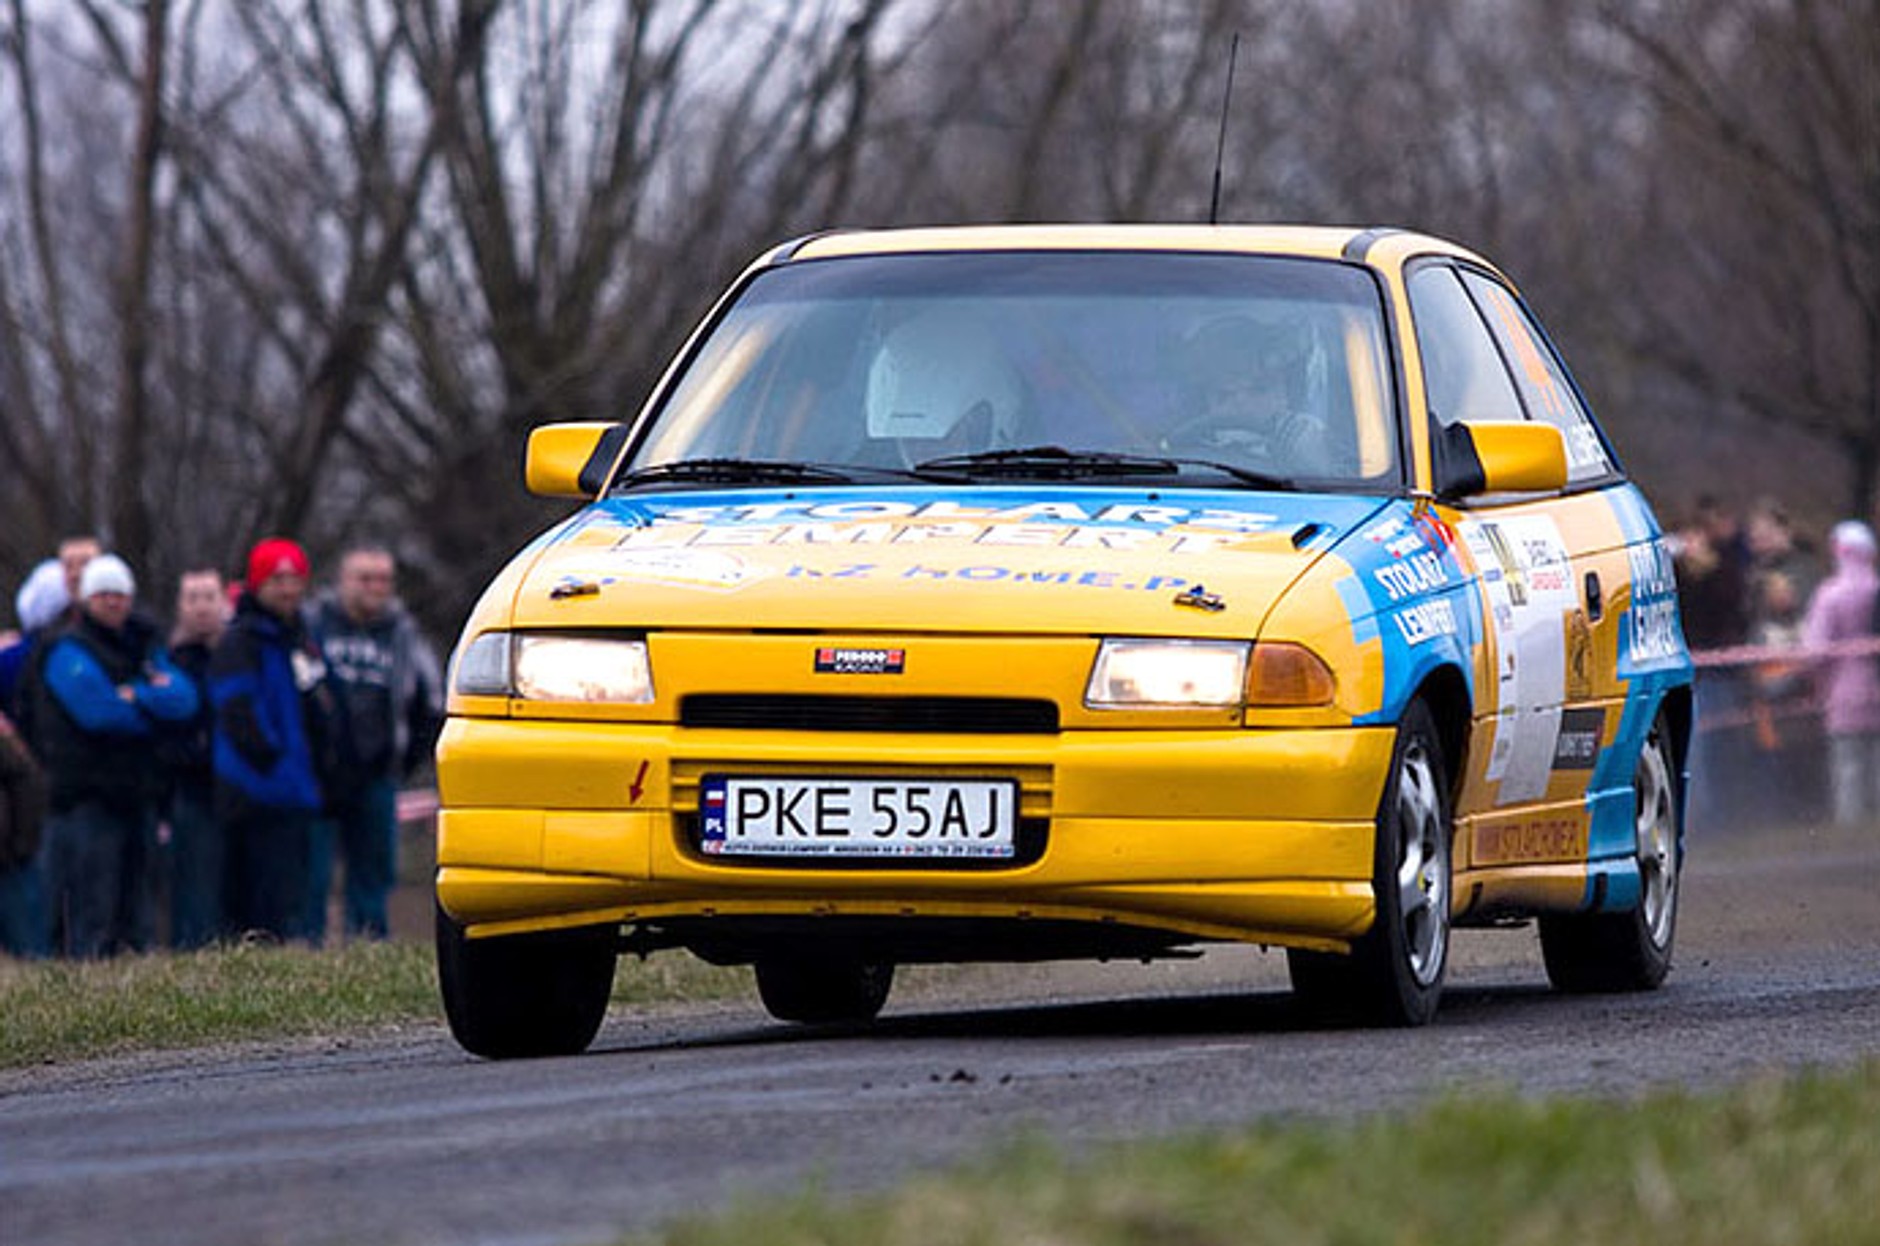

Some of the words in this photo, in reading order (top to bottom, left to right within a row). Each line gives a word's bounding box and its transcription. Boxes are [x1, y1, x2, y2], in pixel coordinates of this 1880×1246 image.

[611, 523, 1247, 553] LEMPERT
[705, 818, 723, 833] PL
[736, 787, 850, 836] PKE
[872, 787, 999, 838] 55AJ
